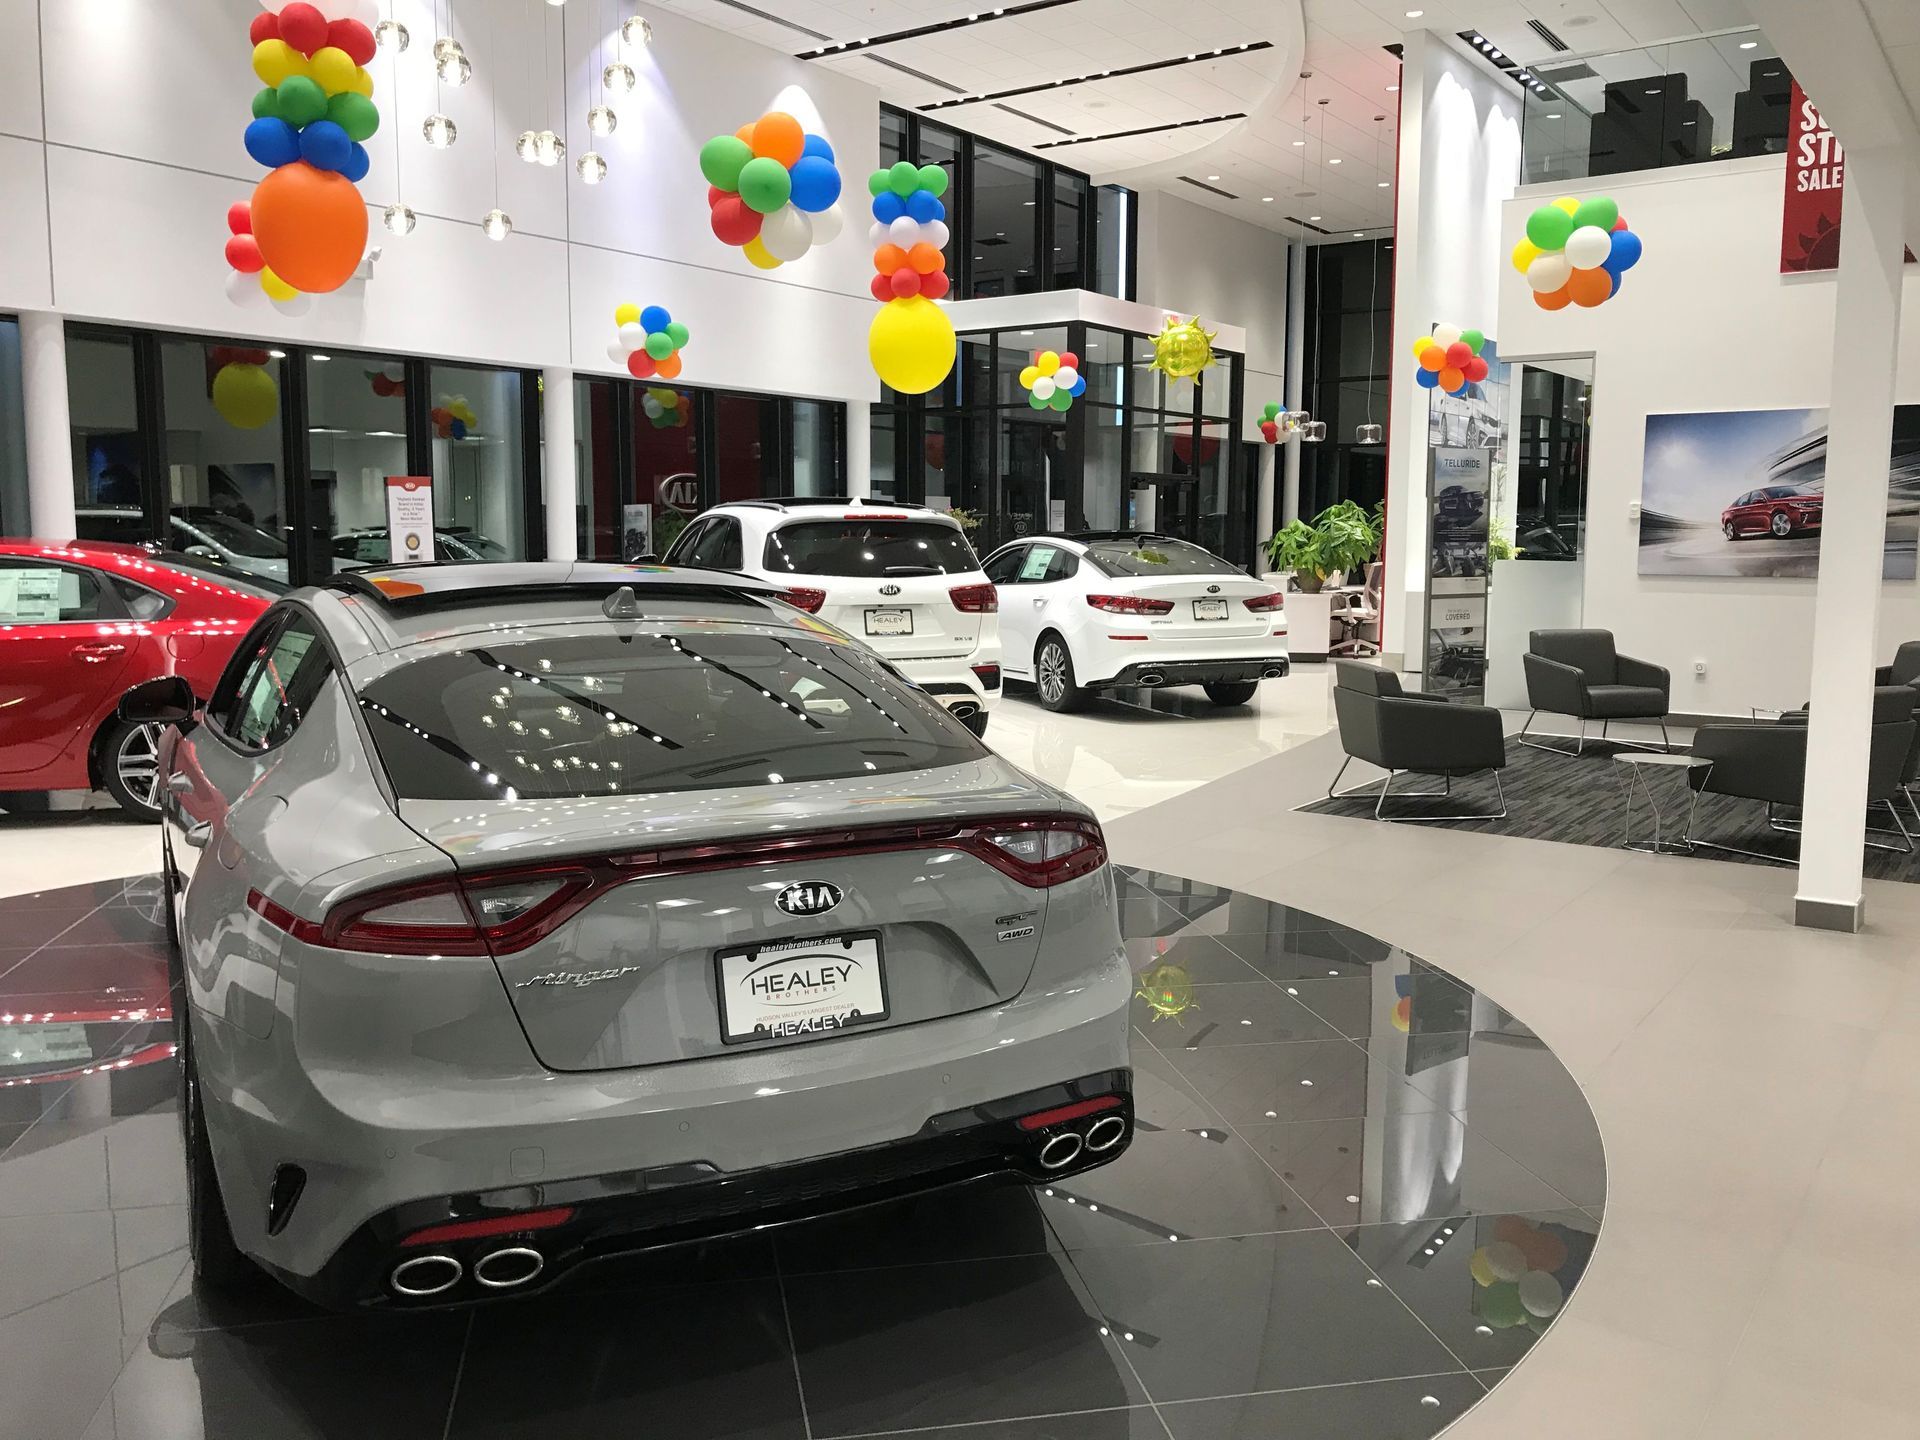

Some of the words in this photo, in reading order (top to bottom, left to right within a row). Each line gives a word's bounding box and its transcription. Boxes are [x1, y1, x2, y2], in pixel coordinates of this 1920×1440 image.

[1797, 166, 1843, 193] SALE
[1444, 458, 1480, 469] TELLURIDE
[873, 616, 904, 624] HEALEY
[1445, 613, 1470, 621] COVERED
[785, 886, 835, 911] KIA
[1001, 928, 1034, 940] AWD
[760, 936, 842, 953] healeybrothers.com
[750, 964, 852, 996] HEALEY
[766, 985, 837, 1001] BROTHERS
[756, 1014, 781, 1023] HUDSON
[807, 1006, 832, 1016] LARGEST
[833, 1002, 855, 1011] DEALER
[771, 1013, 845, 1038] HEALEY
